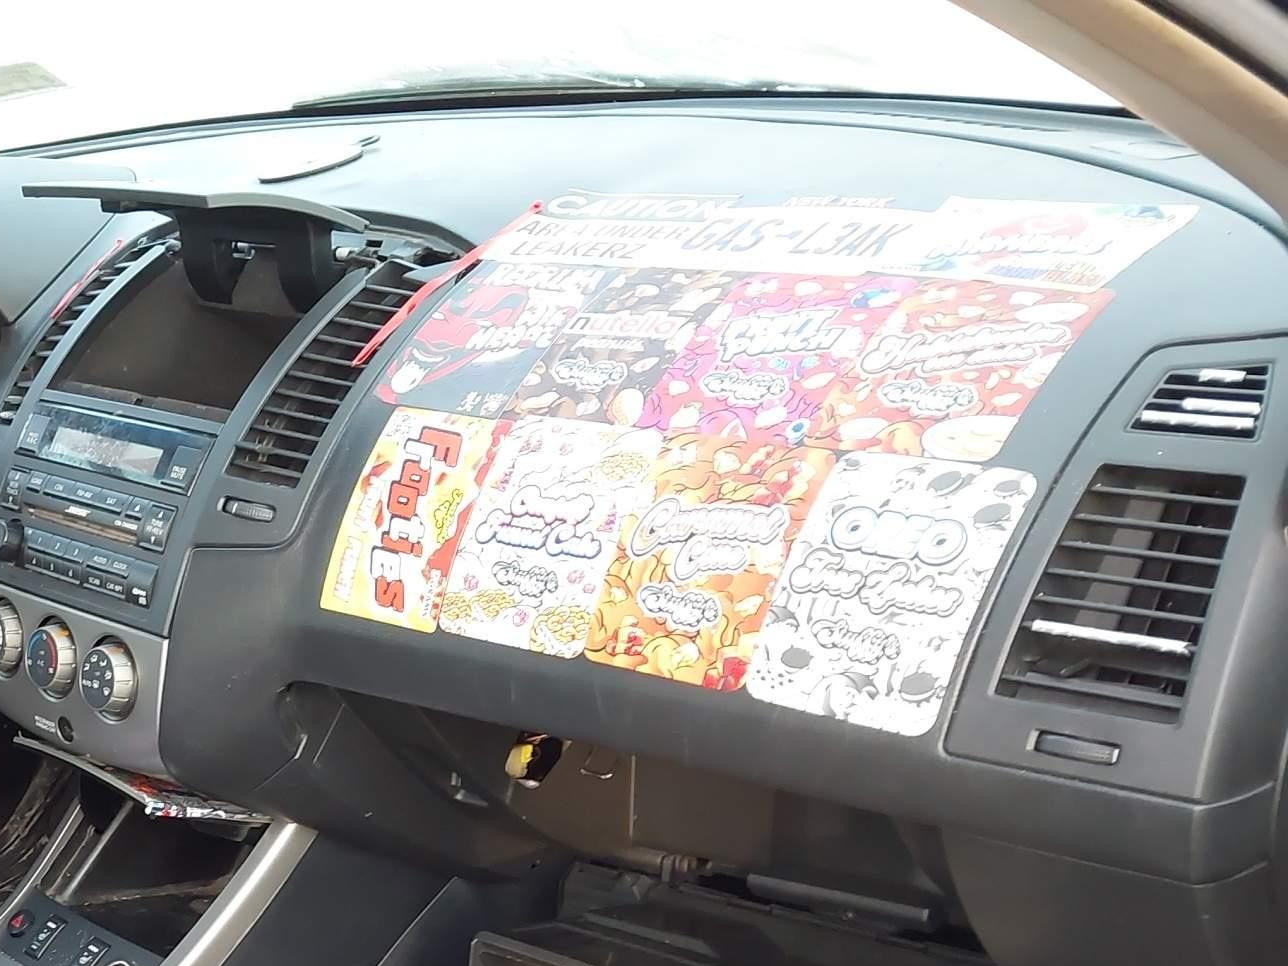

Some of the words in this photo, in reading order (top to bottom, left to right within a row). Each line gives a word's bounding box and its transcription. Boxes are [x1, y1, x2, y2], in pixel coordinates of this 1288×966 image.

[546, 196, 732, 219] CAUTION
[592, 222, 690, 242] UNDER
[509, 240, 648, 261] LEAKERZ
[569, 310, 679, 336] nutella
